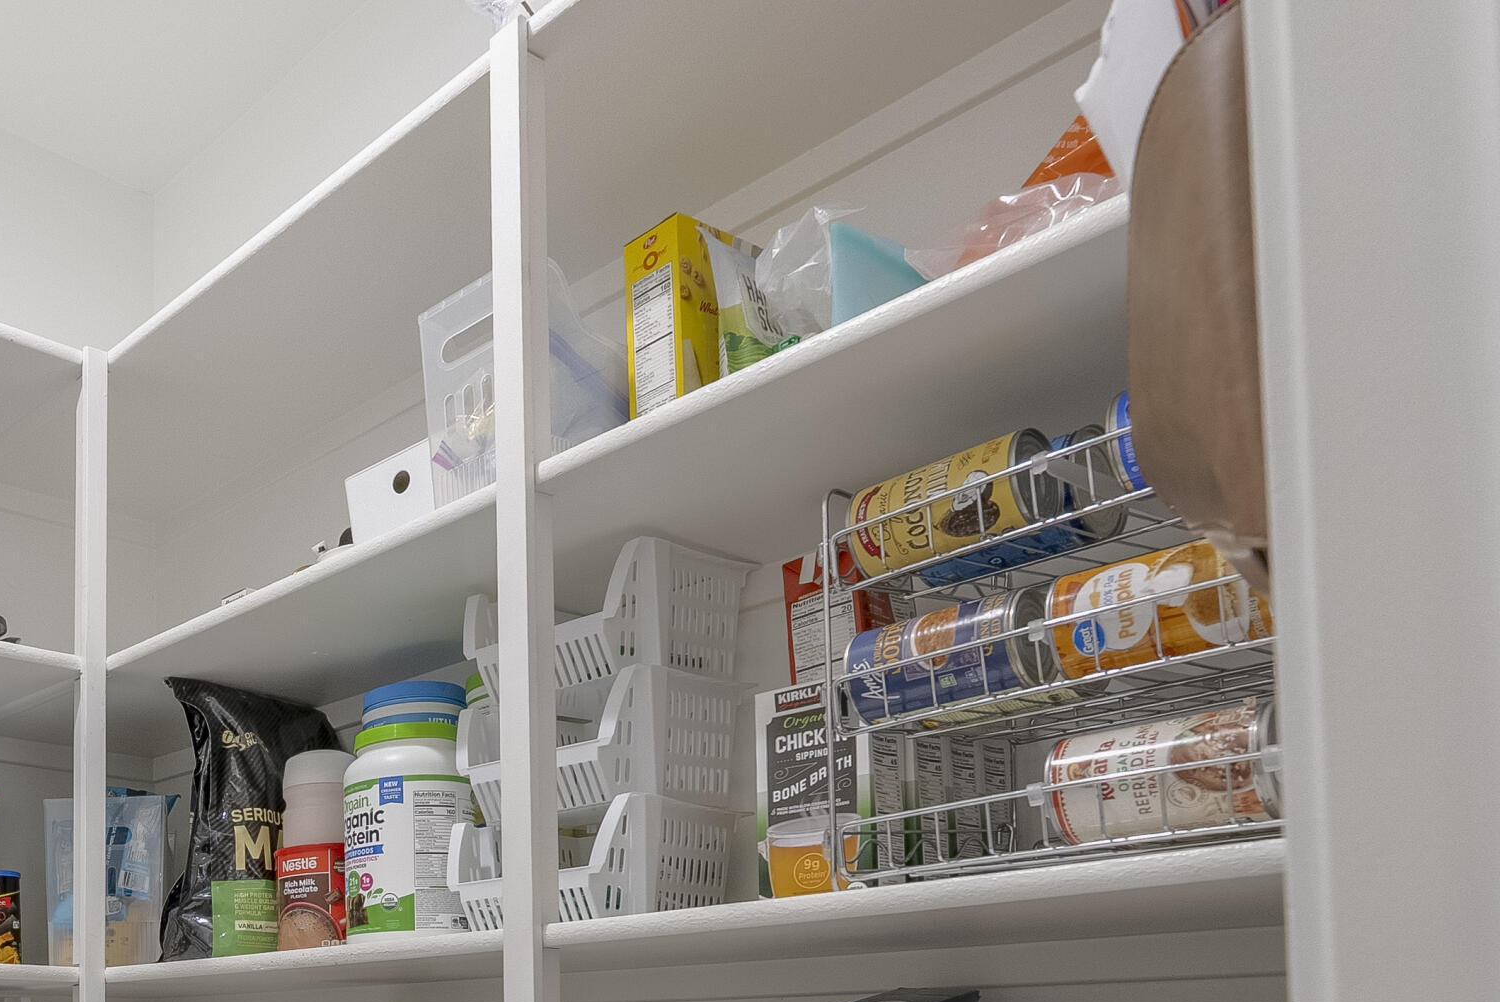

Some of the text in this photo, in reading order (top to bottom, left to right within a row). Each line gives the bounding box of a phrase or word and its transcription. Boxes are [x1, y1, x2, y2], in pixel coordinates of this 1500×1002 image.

[772, 755, 852, 803] BONE BRTH
[803, 859, 820, 871] 9g
[284, 878, 316, 889] Rich Milk
[283, 885, 318, 895] Chocolate
